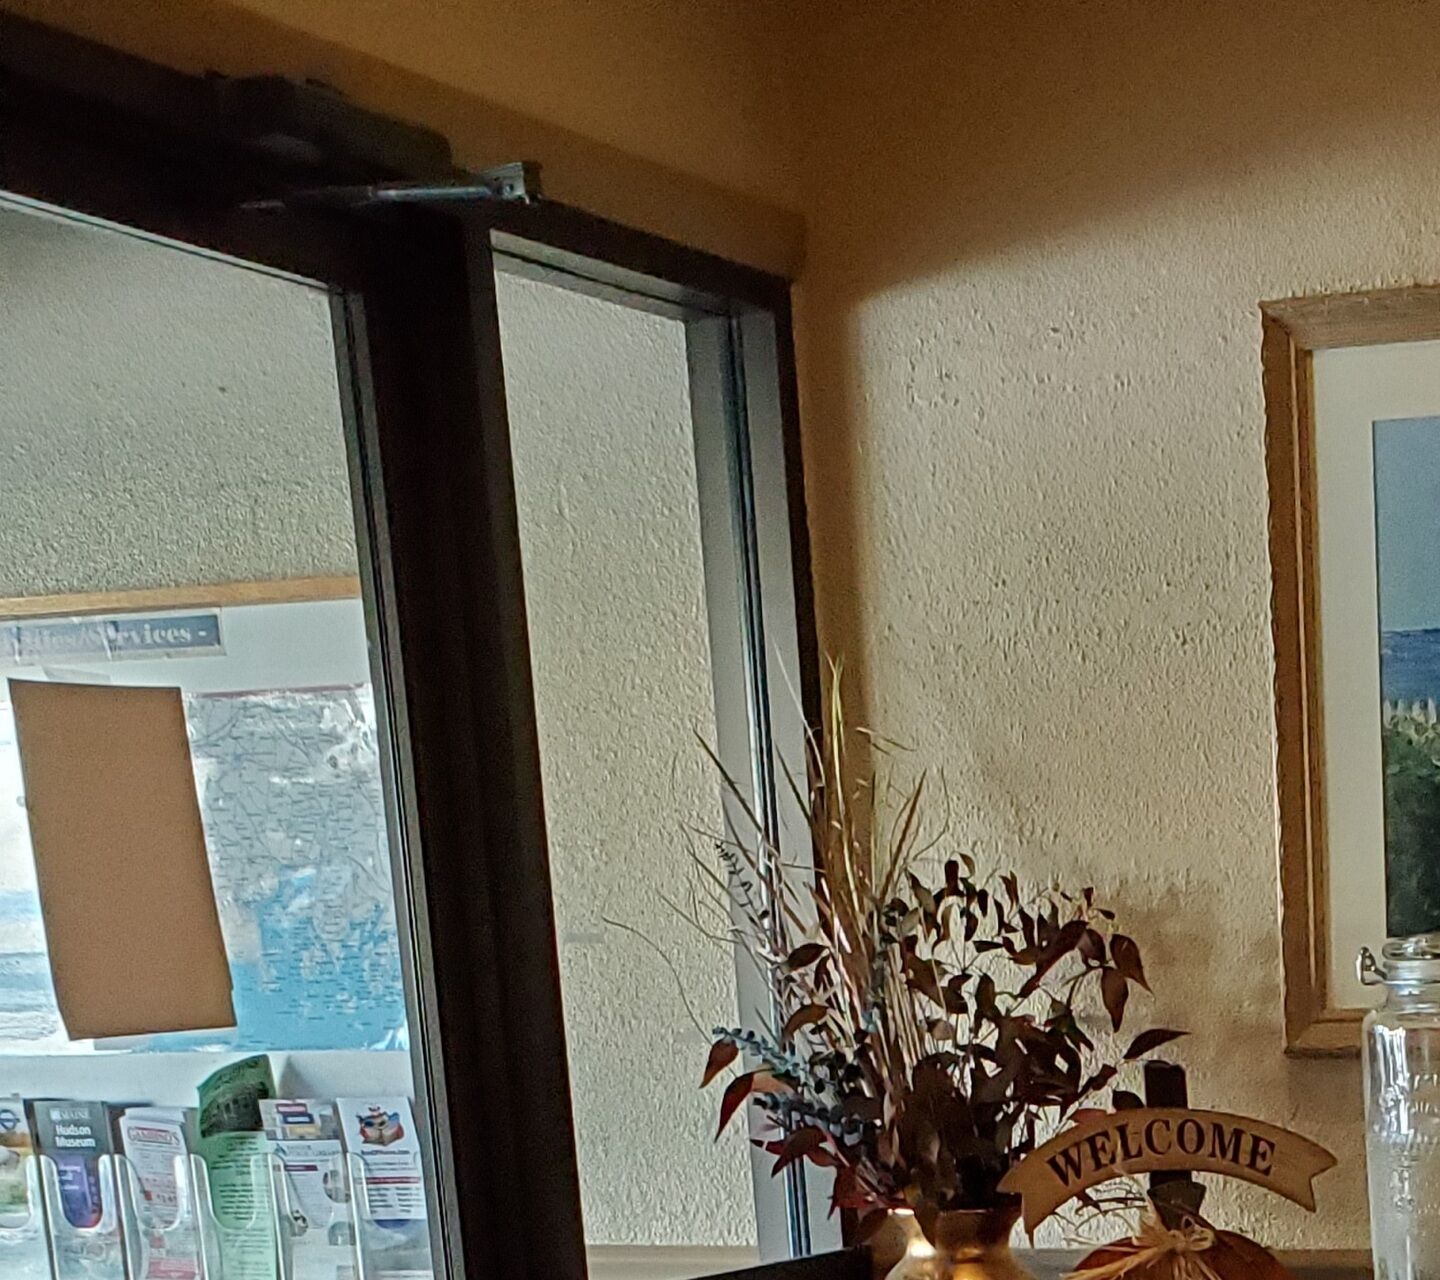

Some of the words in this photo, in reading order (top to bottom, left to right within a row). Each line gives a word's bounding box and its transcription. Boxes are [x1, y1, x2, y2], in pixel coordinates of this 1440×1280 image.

[55, 1124, 91, 1136] Hudson
[55, 1136, 96, 1148] Museum
[1046, 1118, 1277, 1188] WELCOME
